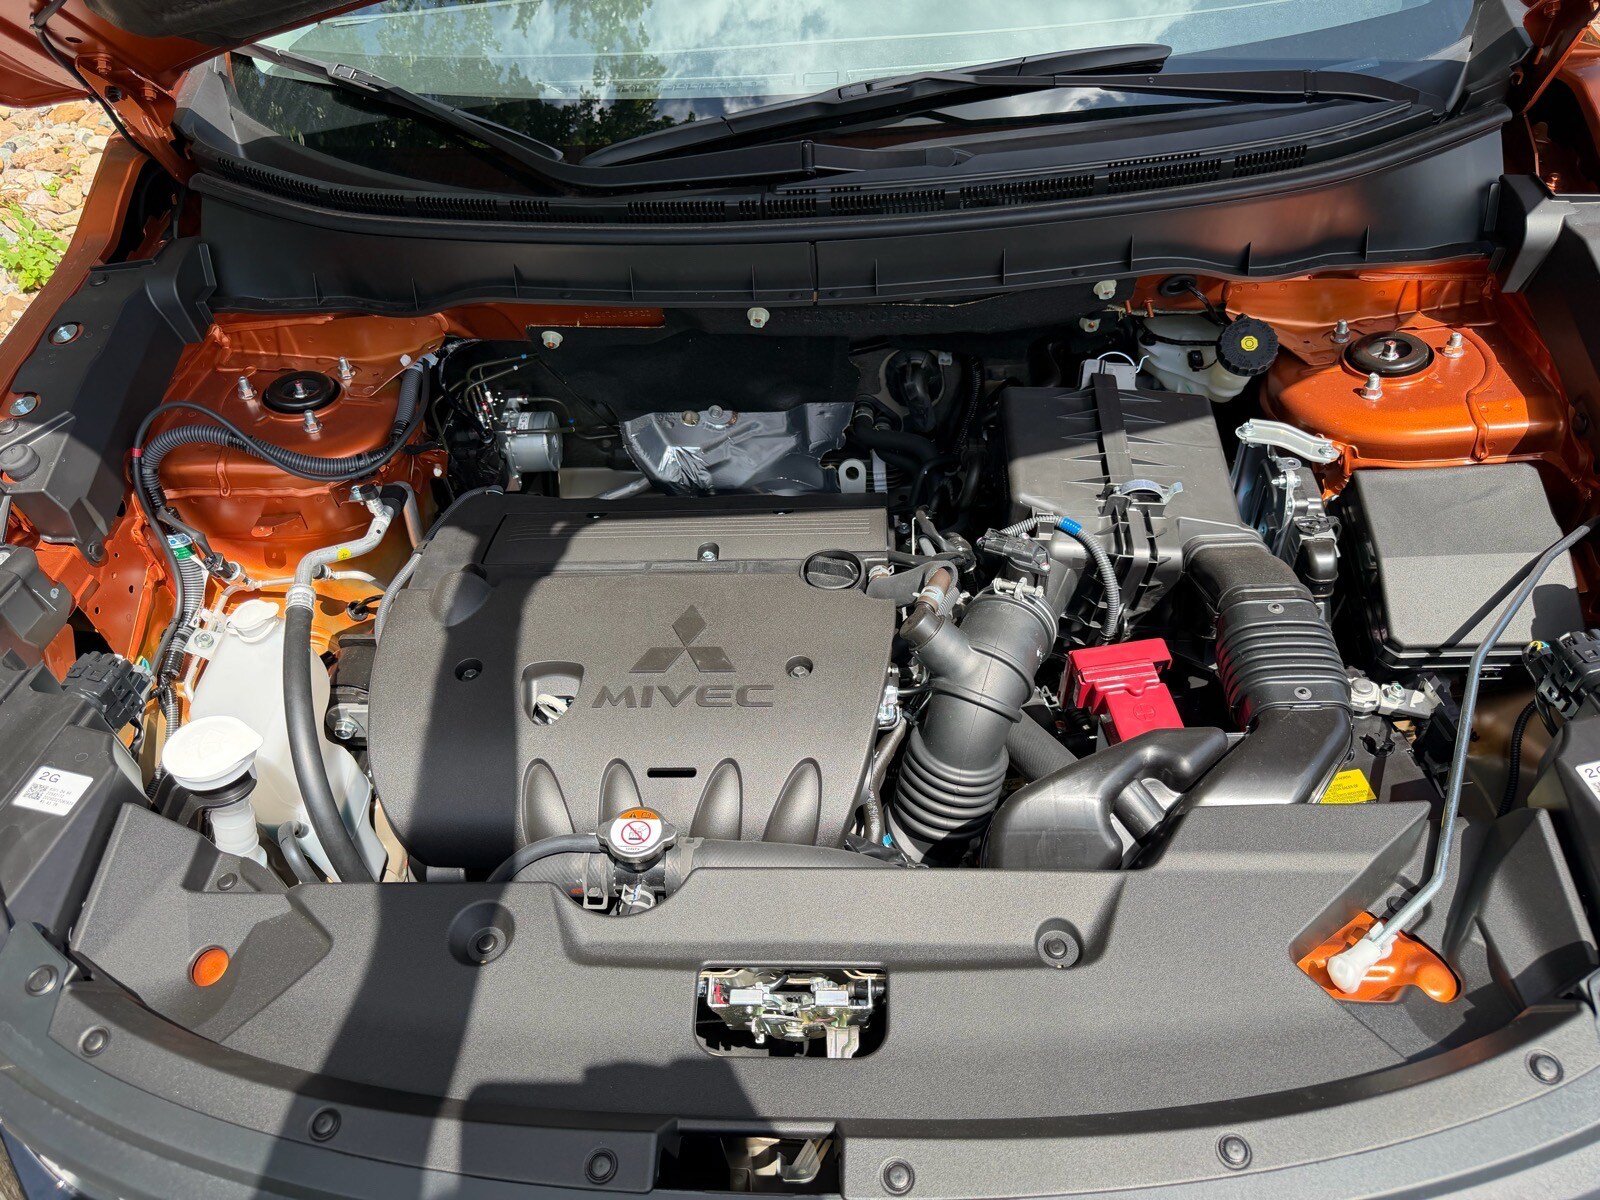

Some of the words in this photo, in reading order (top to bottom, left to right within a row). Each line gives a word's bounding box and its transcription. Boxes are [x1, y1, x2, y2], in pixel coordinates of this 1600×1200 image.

[592, 684, 775, 709] MIVEC
[38, 771, 61, 784] 2G
[1584, 765, 1600, 779] 2
